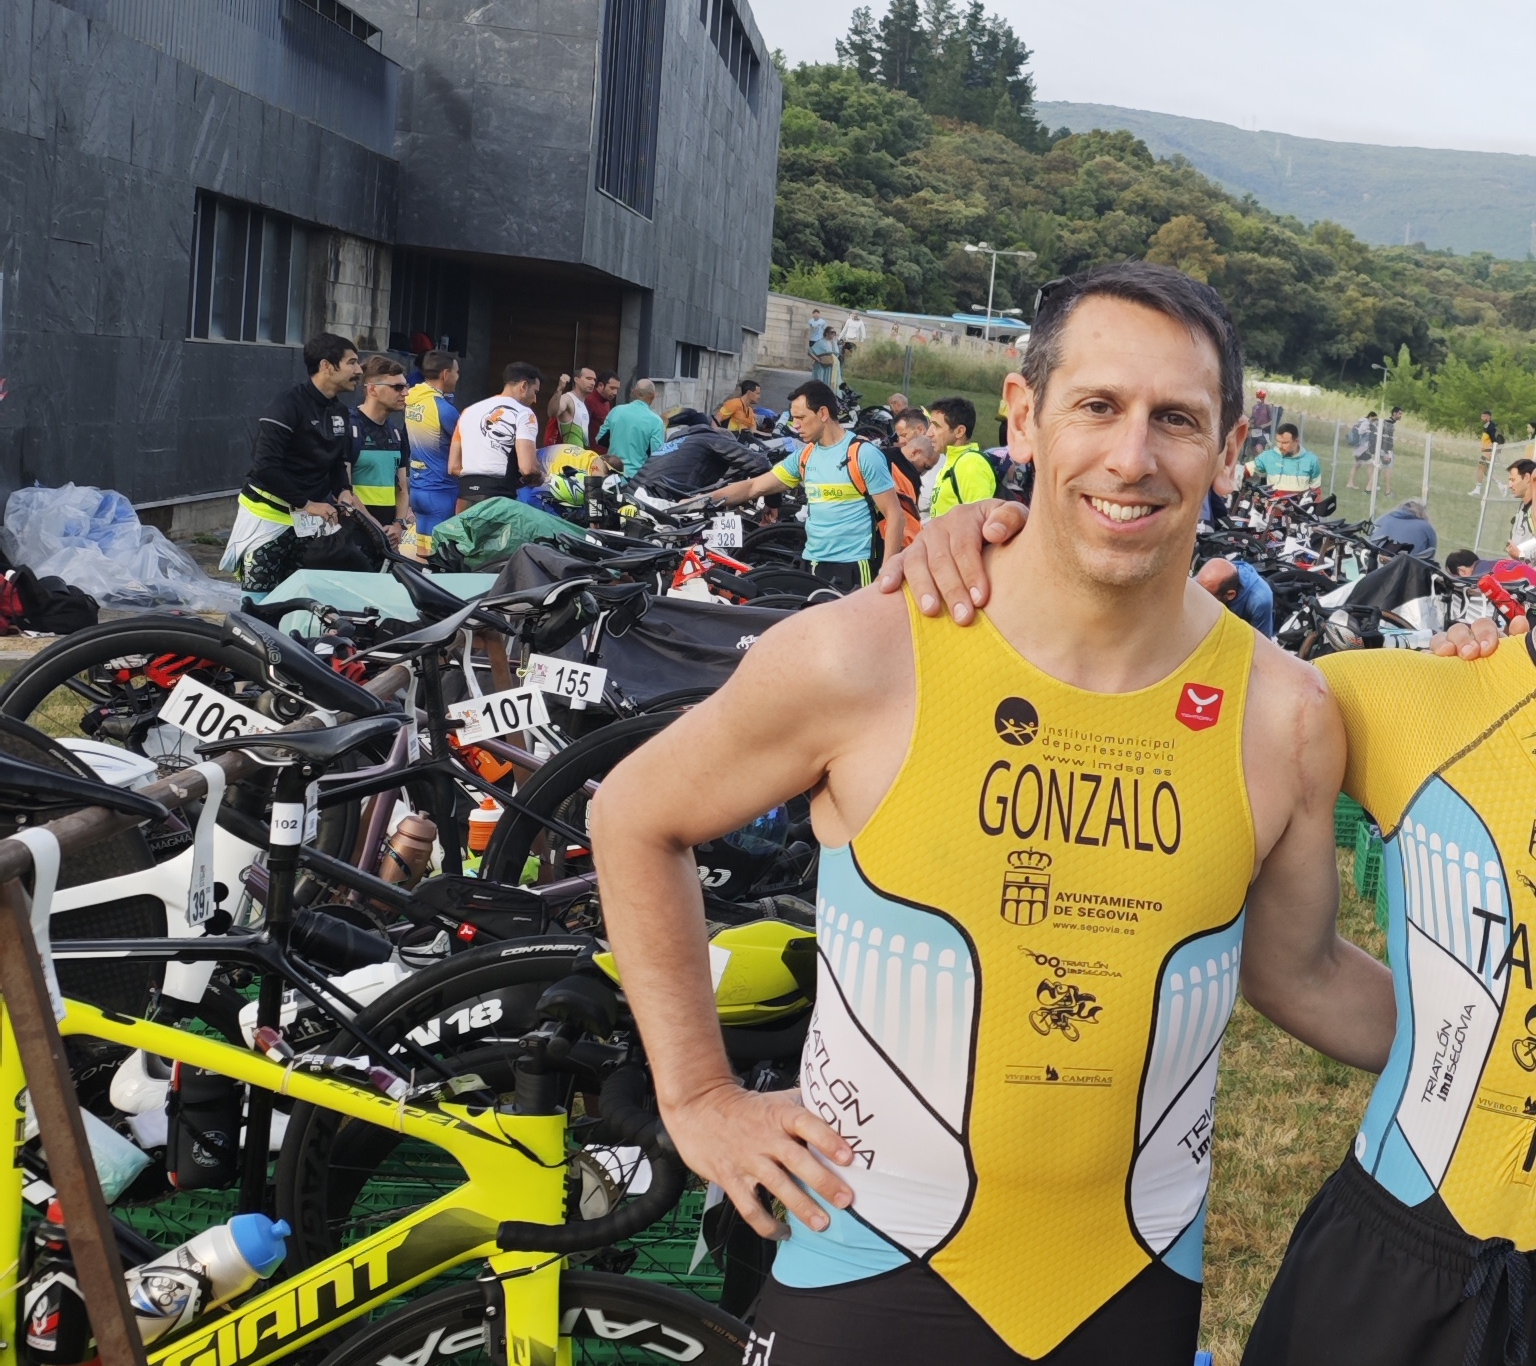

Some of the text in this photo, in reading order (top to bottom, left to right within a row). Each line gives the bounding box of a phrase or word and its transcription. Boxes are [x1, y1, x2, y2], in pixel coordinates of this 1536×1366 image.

[555, 666, 592, 698] 155
[179, 692, 248, 740] 106
[482, 692, 535, 733] 107
[978, 759, 1181, 855] GONZALO
[274, 819, 298, 829] 102
[1055, 892, 1163, 912] AYUNTAMIENTO
[1054, 905, 1139, 923] DE SEGOVIA
[1052, 921, 1136, 936] www.segovia.es
[1421, 1019, 1452, 1103] TRIATLÓN
[1005, 1073, 1114, 1084] VIVEROS CAMPIÑAS
[1479, 1097, 1518, 1113] VIVEROS
